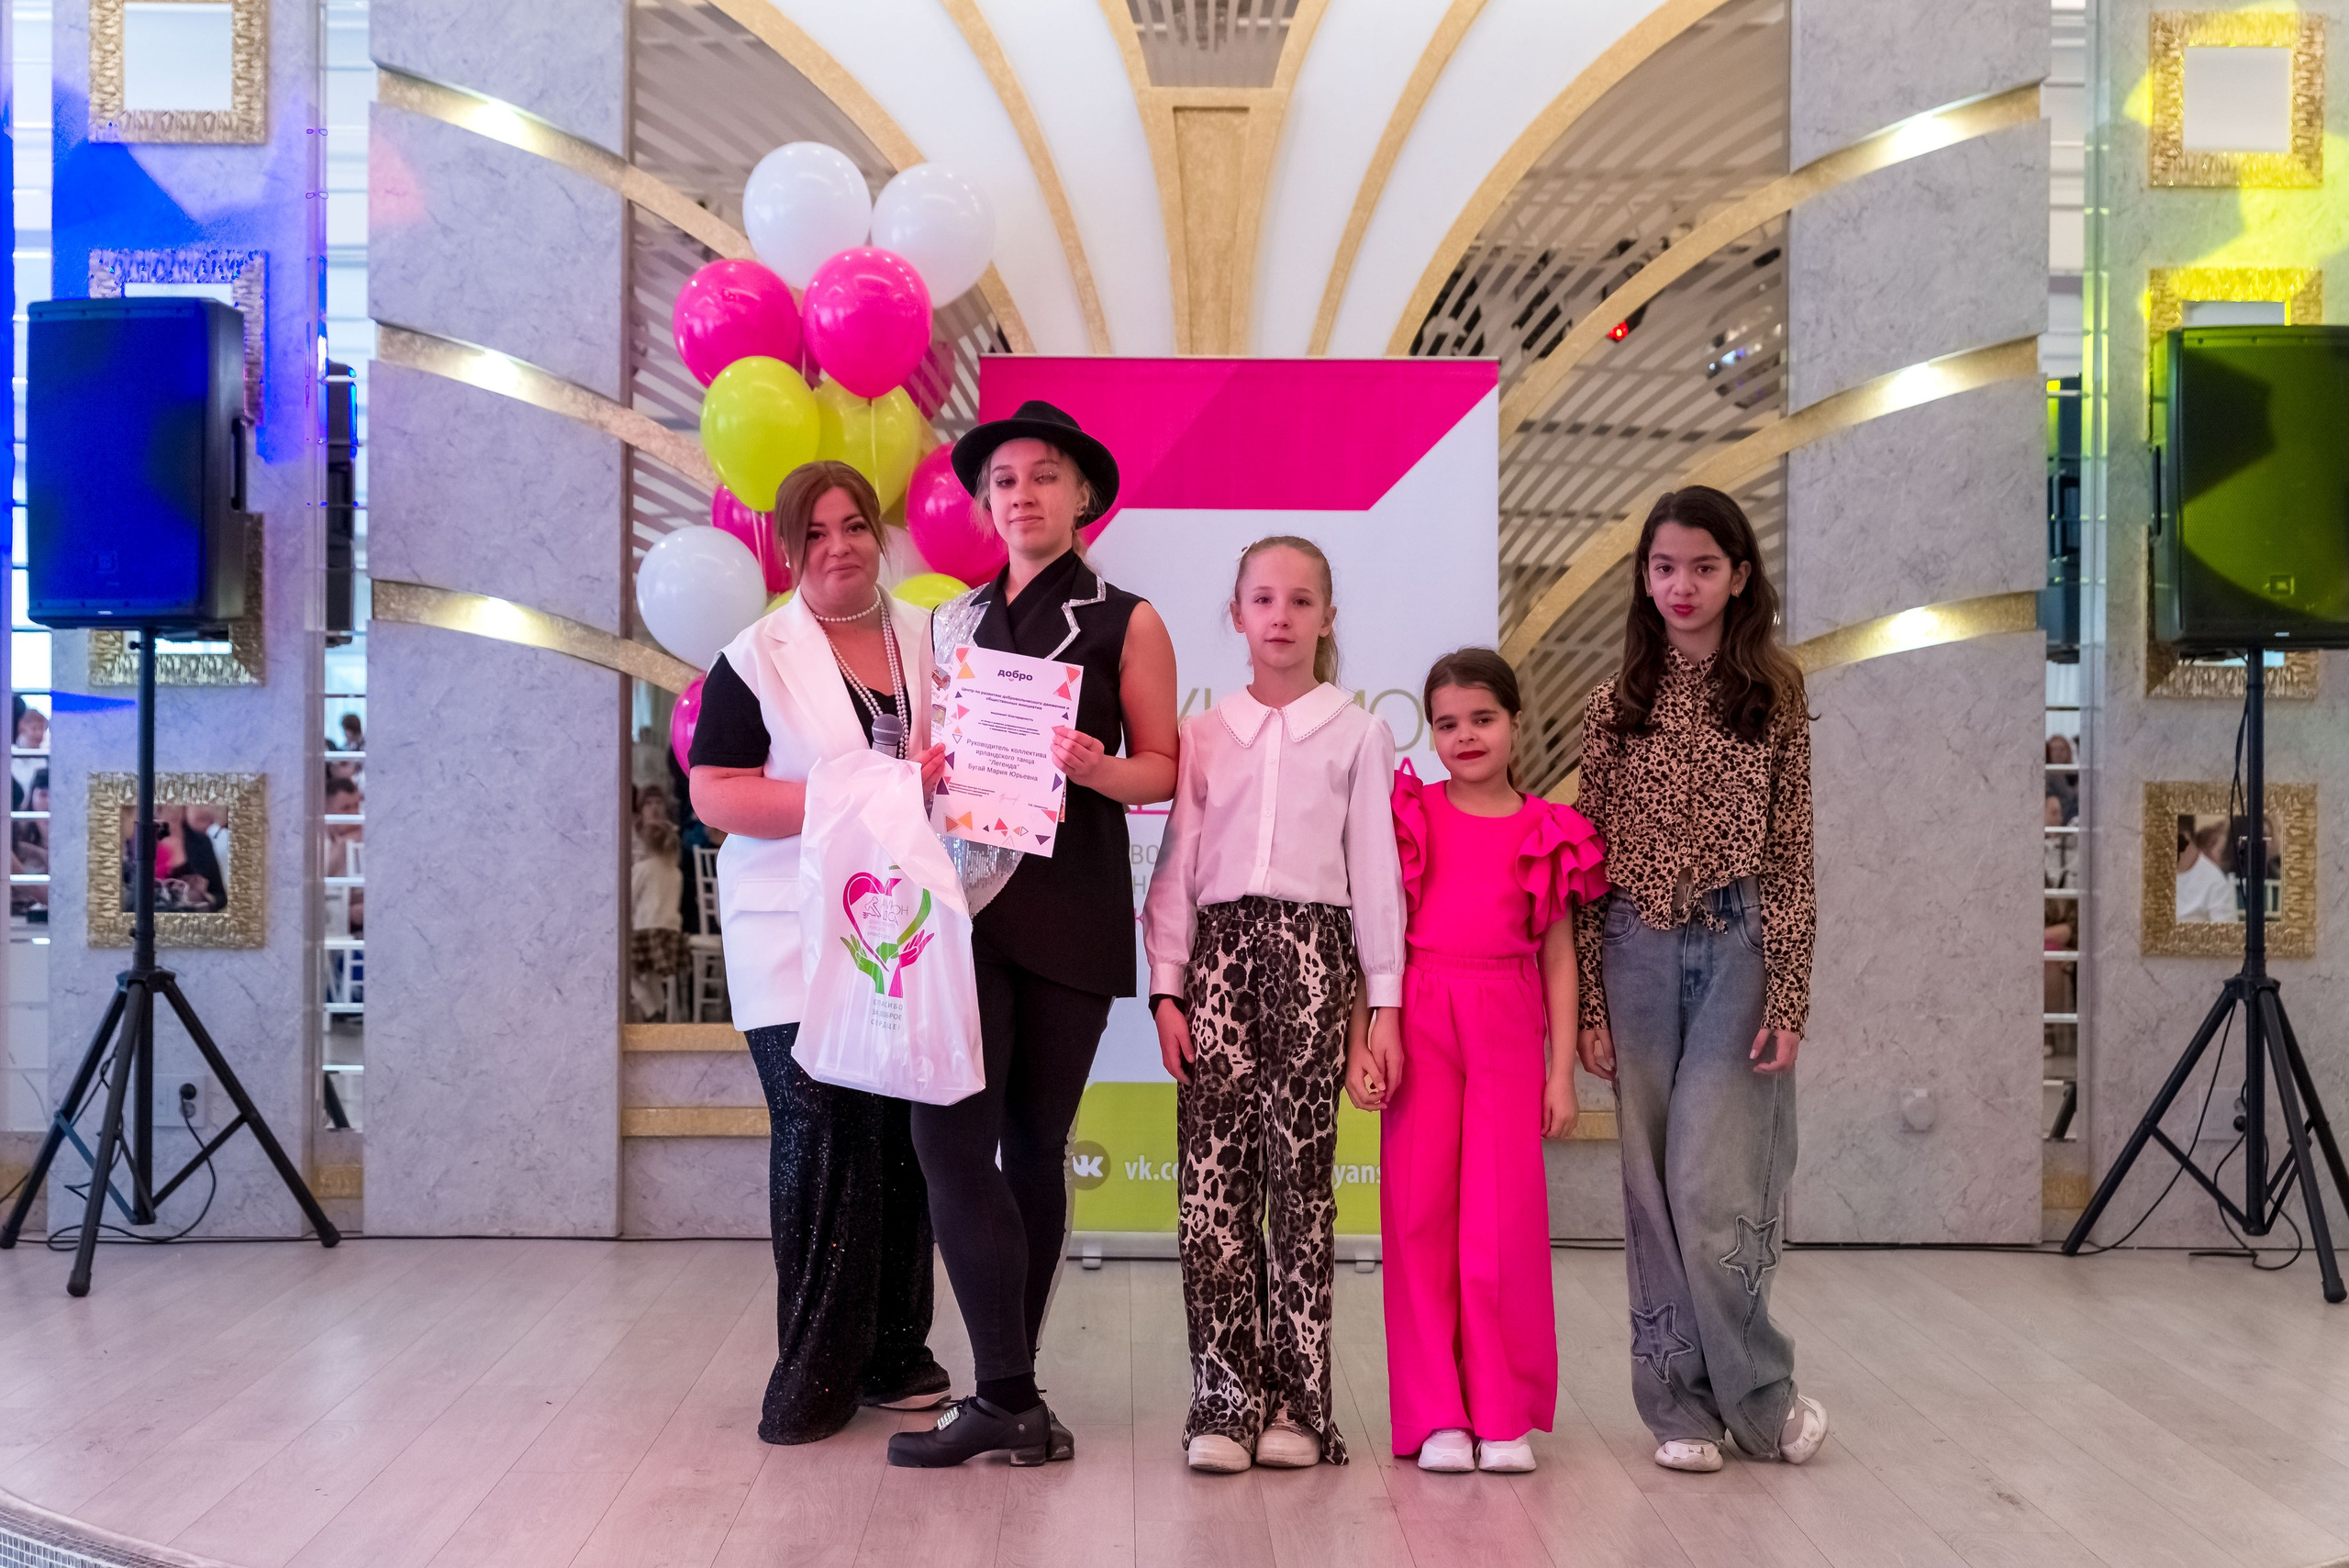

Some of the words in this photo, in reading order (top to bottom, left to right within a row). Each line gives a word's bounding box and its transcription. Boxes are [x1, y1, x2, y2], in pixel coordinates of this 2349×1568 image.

[997, 669, 1033, 682] добро
[1002, 695, 1042, 706] добровольческого
[966, 739, 1009, 752] Руководитель
[1010, 748, 1047, 759] коллектива
[975, 750, 1015, 762] ирландского
[1017, 756, 1035, 765] танца
[988, 759, 1020, 770] "Легенда"
[967, 762, 985, 773] Бугай
[986, 767, 1008, 777] Мария
[1009, 771, 1038, 782] Юрьевна
[873, 998, 904, 1011] СПАСИБО
[1333, 1164, 1381, 1191] yan
